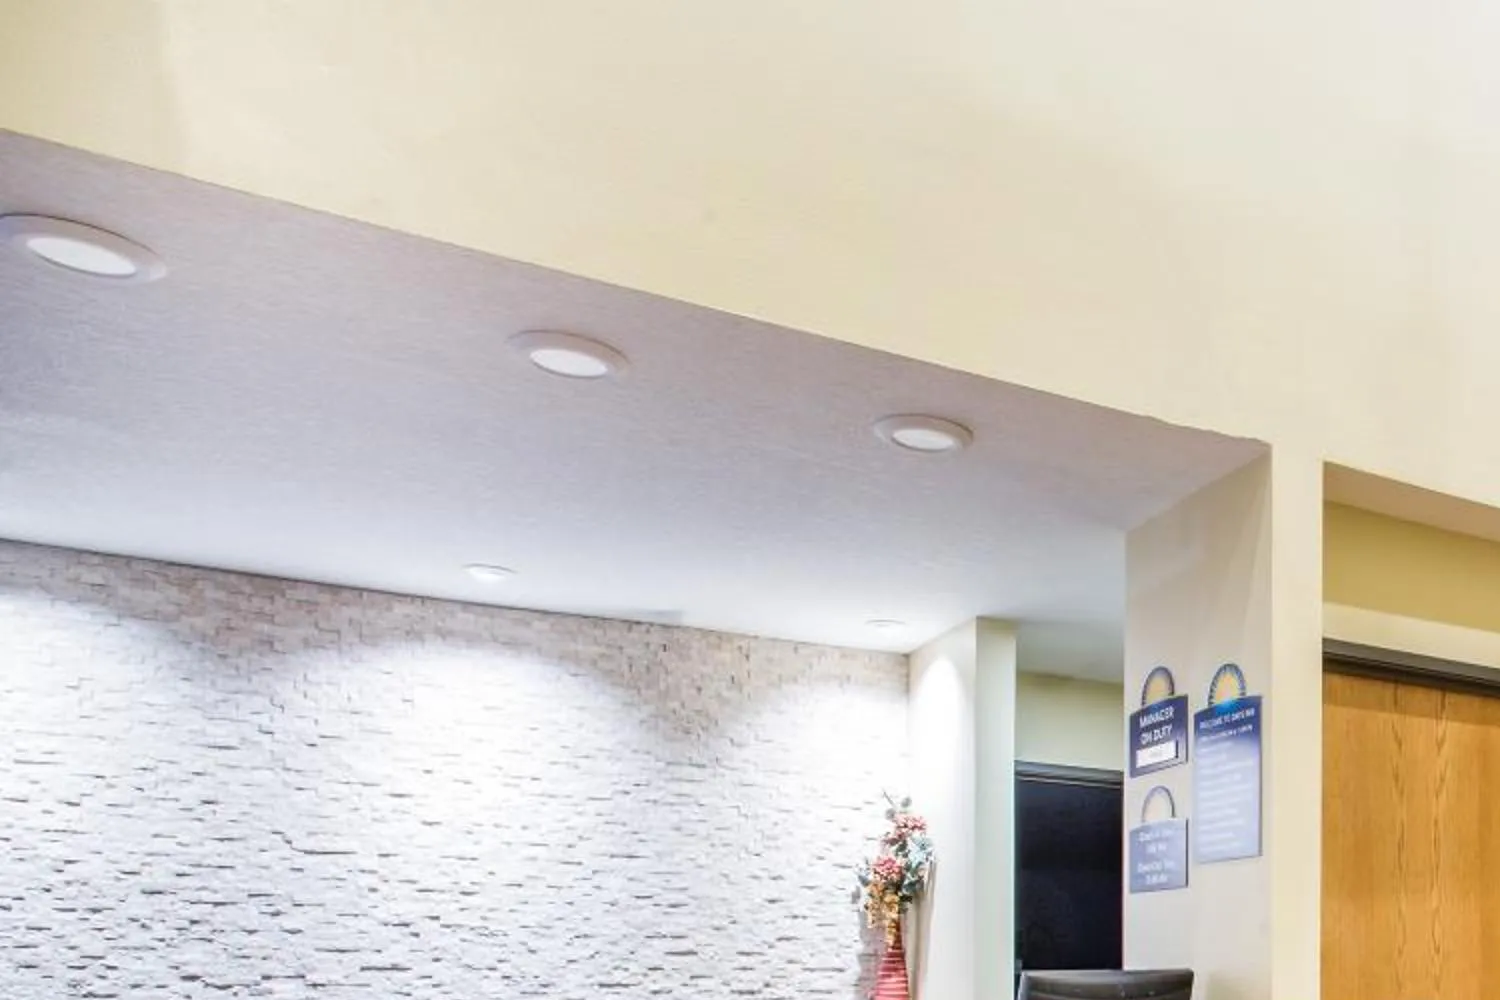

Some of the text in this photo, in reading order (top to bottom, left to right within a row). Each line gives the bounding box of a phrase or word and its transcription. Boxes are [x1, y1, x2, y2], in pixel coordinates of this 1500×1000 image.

[1139, 705, 1175, 729] MANAGER
[1140, 723, 1174, 745] ON DUTY
